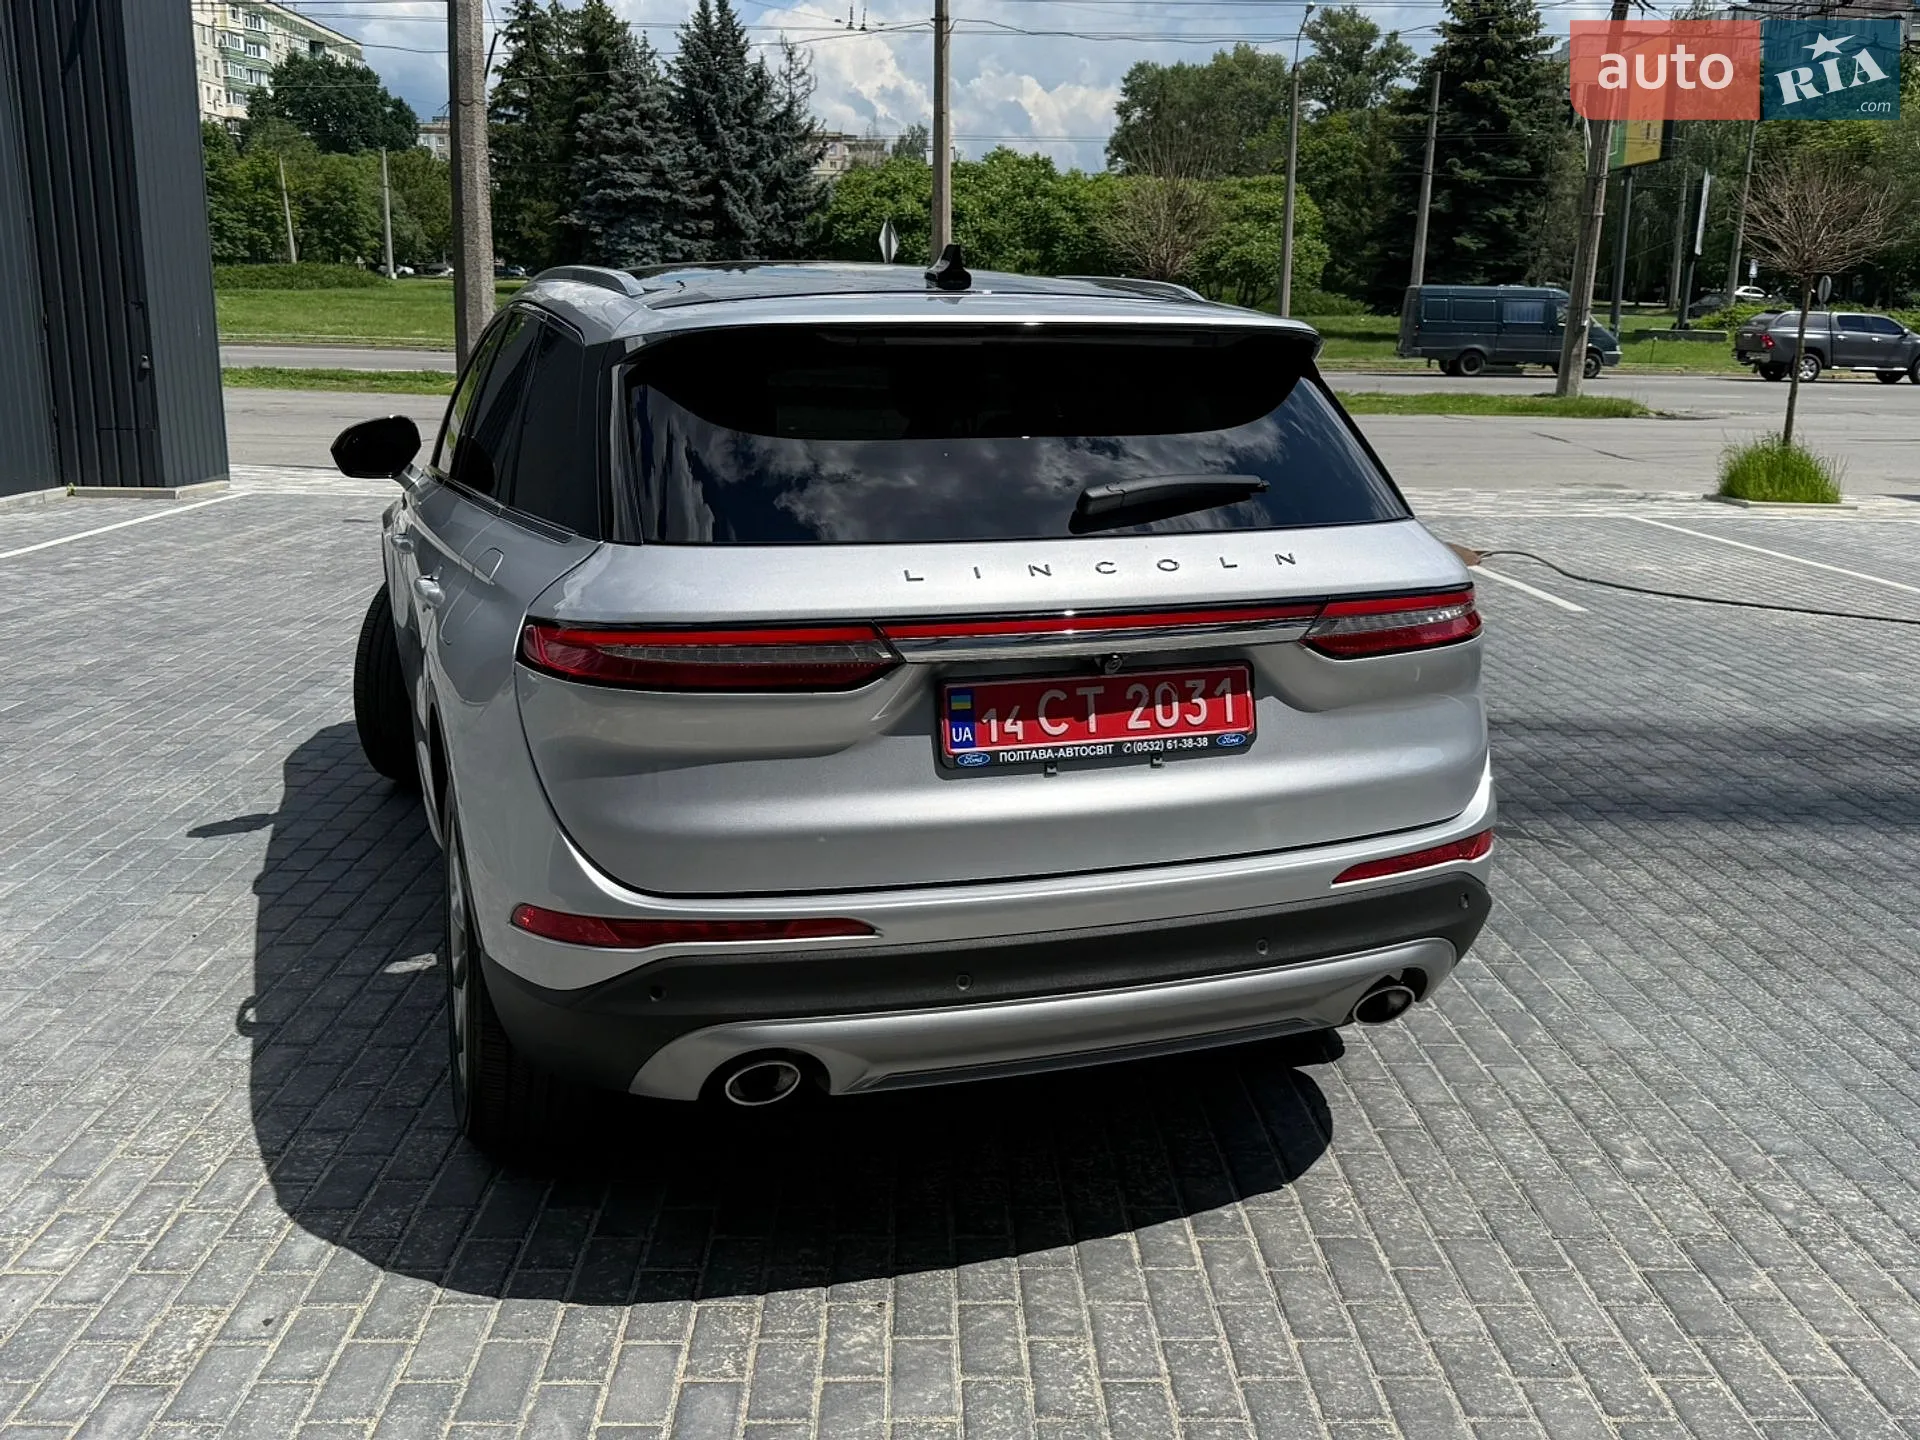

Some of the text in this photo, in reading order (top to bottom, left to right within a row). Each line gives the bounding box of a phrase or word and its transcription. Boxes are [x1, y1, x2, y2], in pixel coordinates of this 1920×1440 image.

[903, 551, 1297, 583] LINCOLN
[981, 677, 1234, 743] 14 CT 2031
[952, 726, 974, 743] UA
[999, 744, 1114, 763] ПОЛТАВА-АВТОСВІТ
[1133, 737, 1208, 754] (0532) 61-38-38
